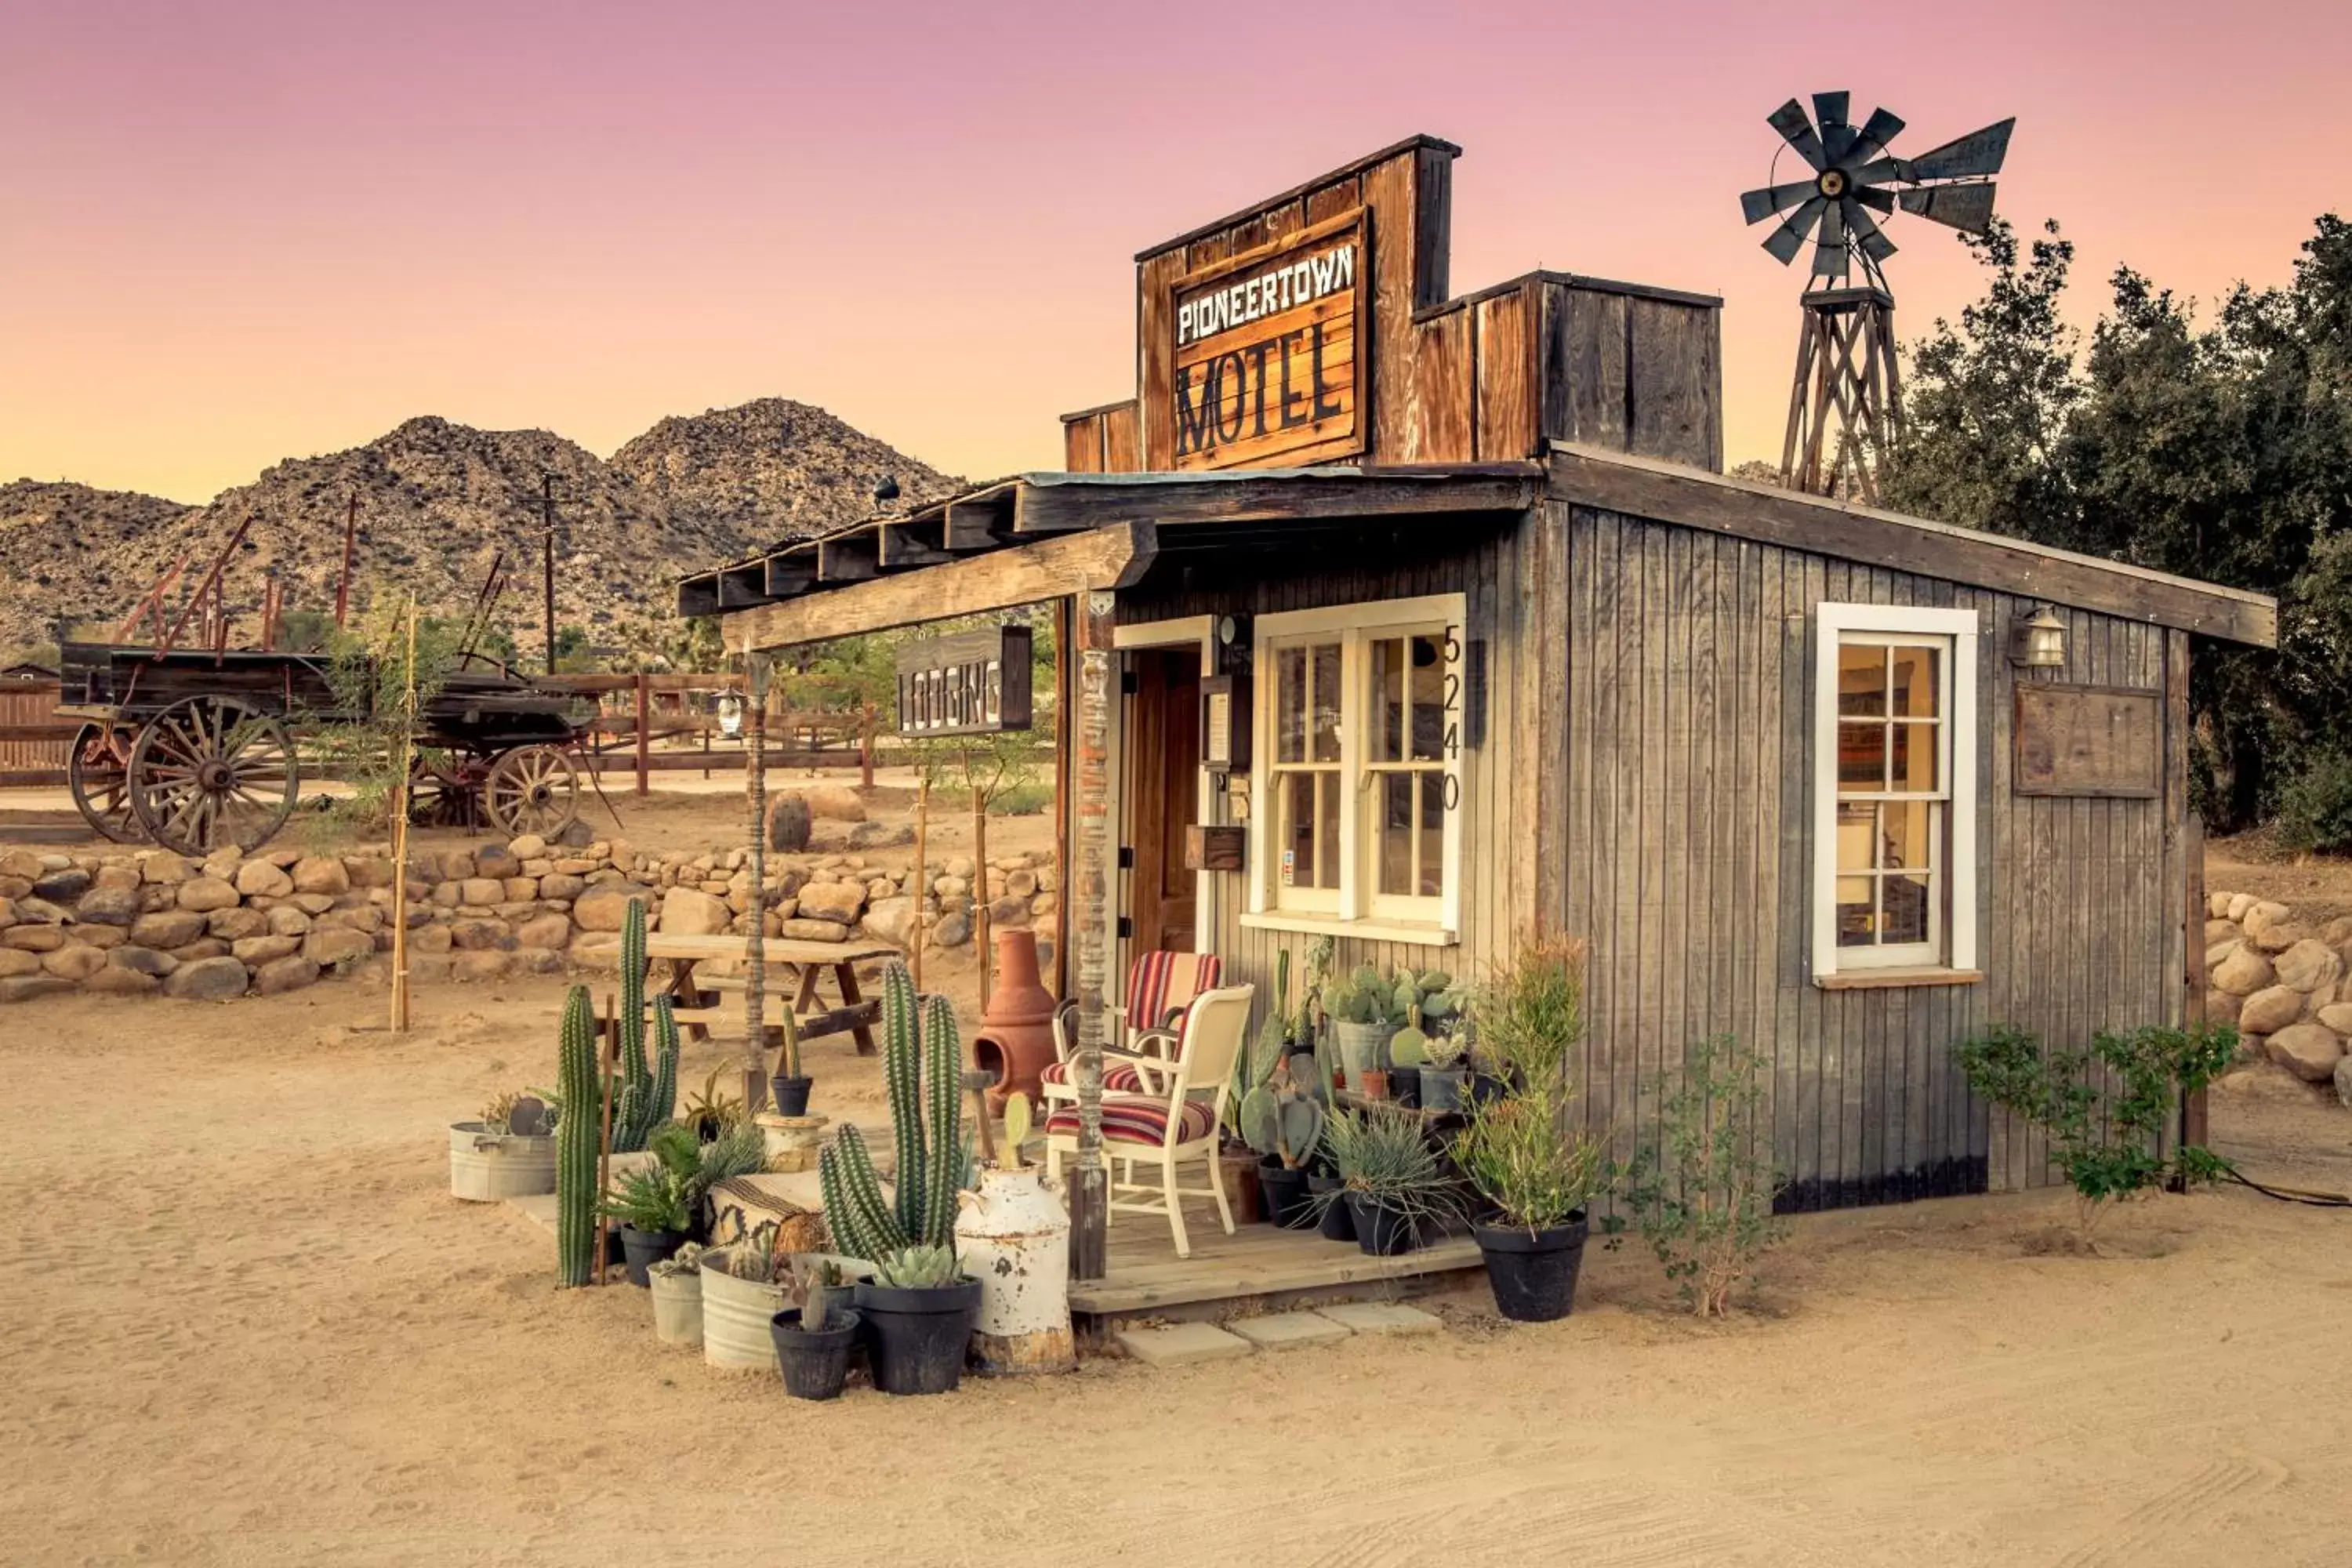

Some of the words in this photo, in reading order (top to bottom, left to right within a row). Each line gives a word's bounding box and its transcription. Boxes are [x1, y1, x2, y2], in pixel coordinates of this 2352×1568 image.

[1178, 243, 1353, 345] PIONEERTOWN
[1178, 323, 1341, 456] MOTEL
[898, 660, 1000, 731] LODGING
[1443, 624, 1461, 811] 5240
